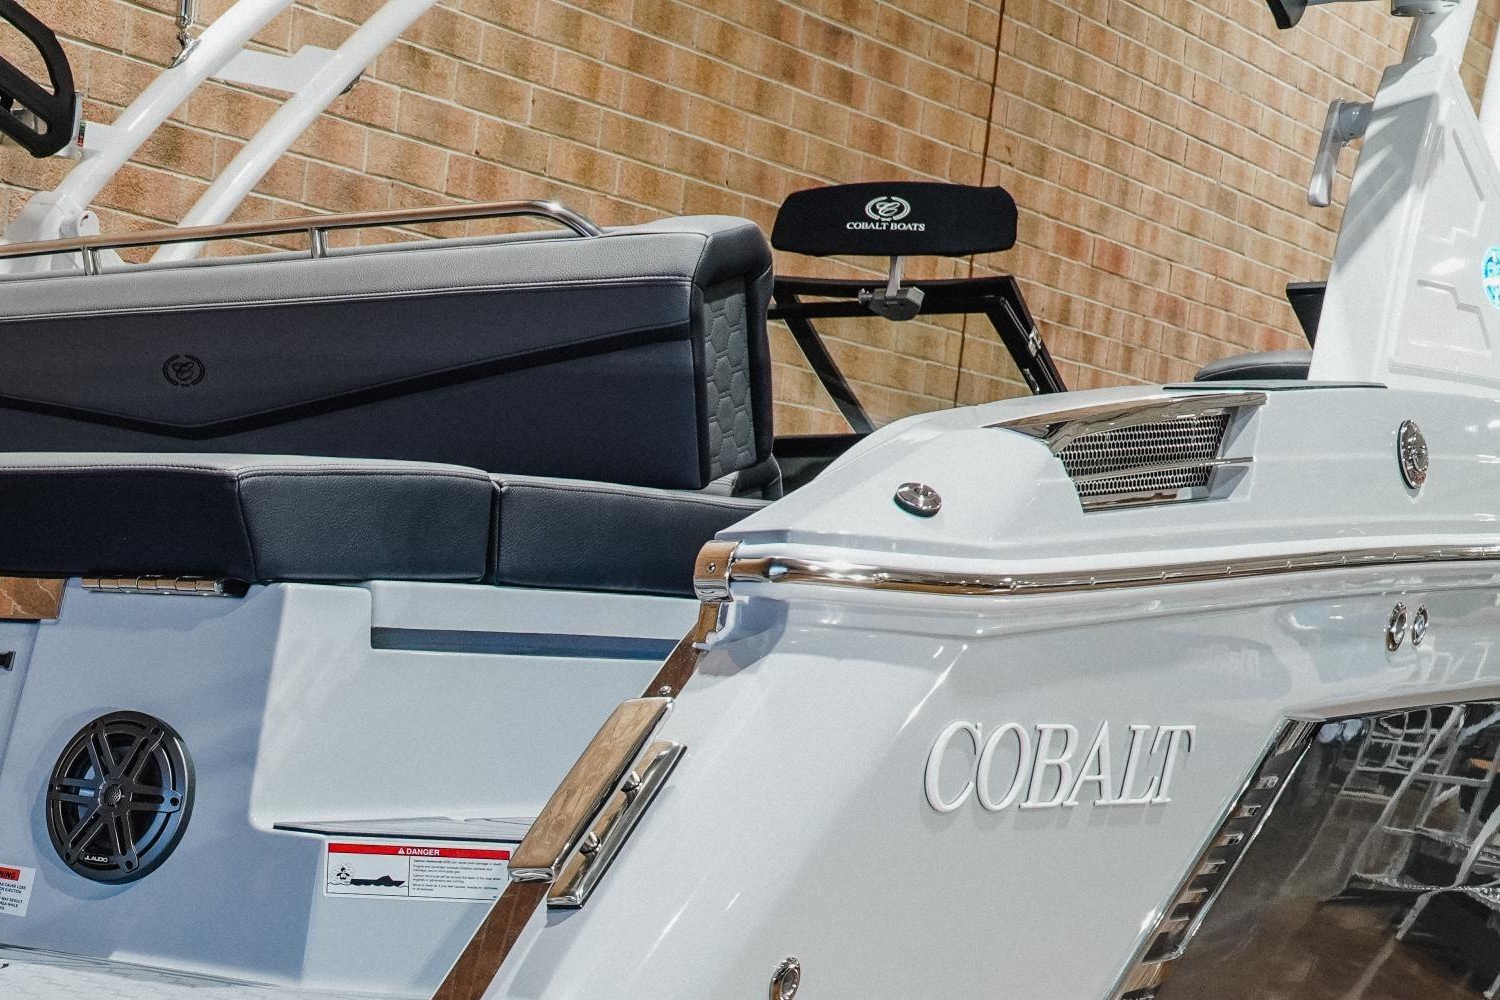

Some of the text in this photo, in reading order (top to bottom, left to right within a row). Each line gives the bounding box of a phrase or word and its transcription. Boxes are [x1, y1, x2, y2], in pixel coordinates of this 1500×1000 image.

[847, 222, 925, 231] COBALT BOATS
[924, 719, 1196, 814] COBALT
[406, 848, 440, 856] DANGER
